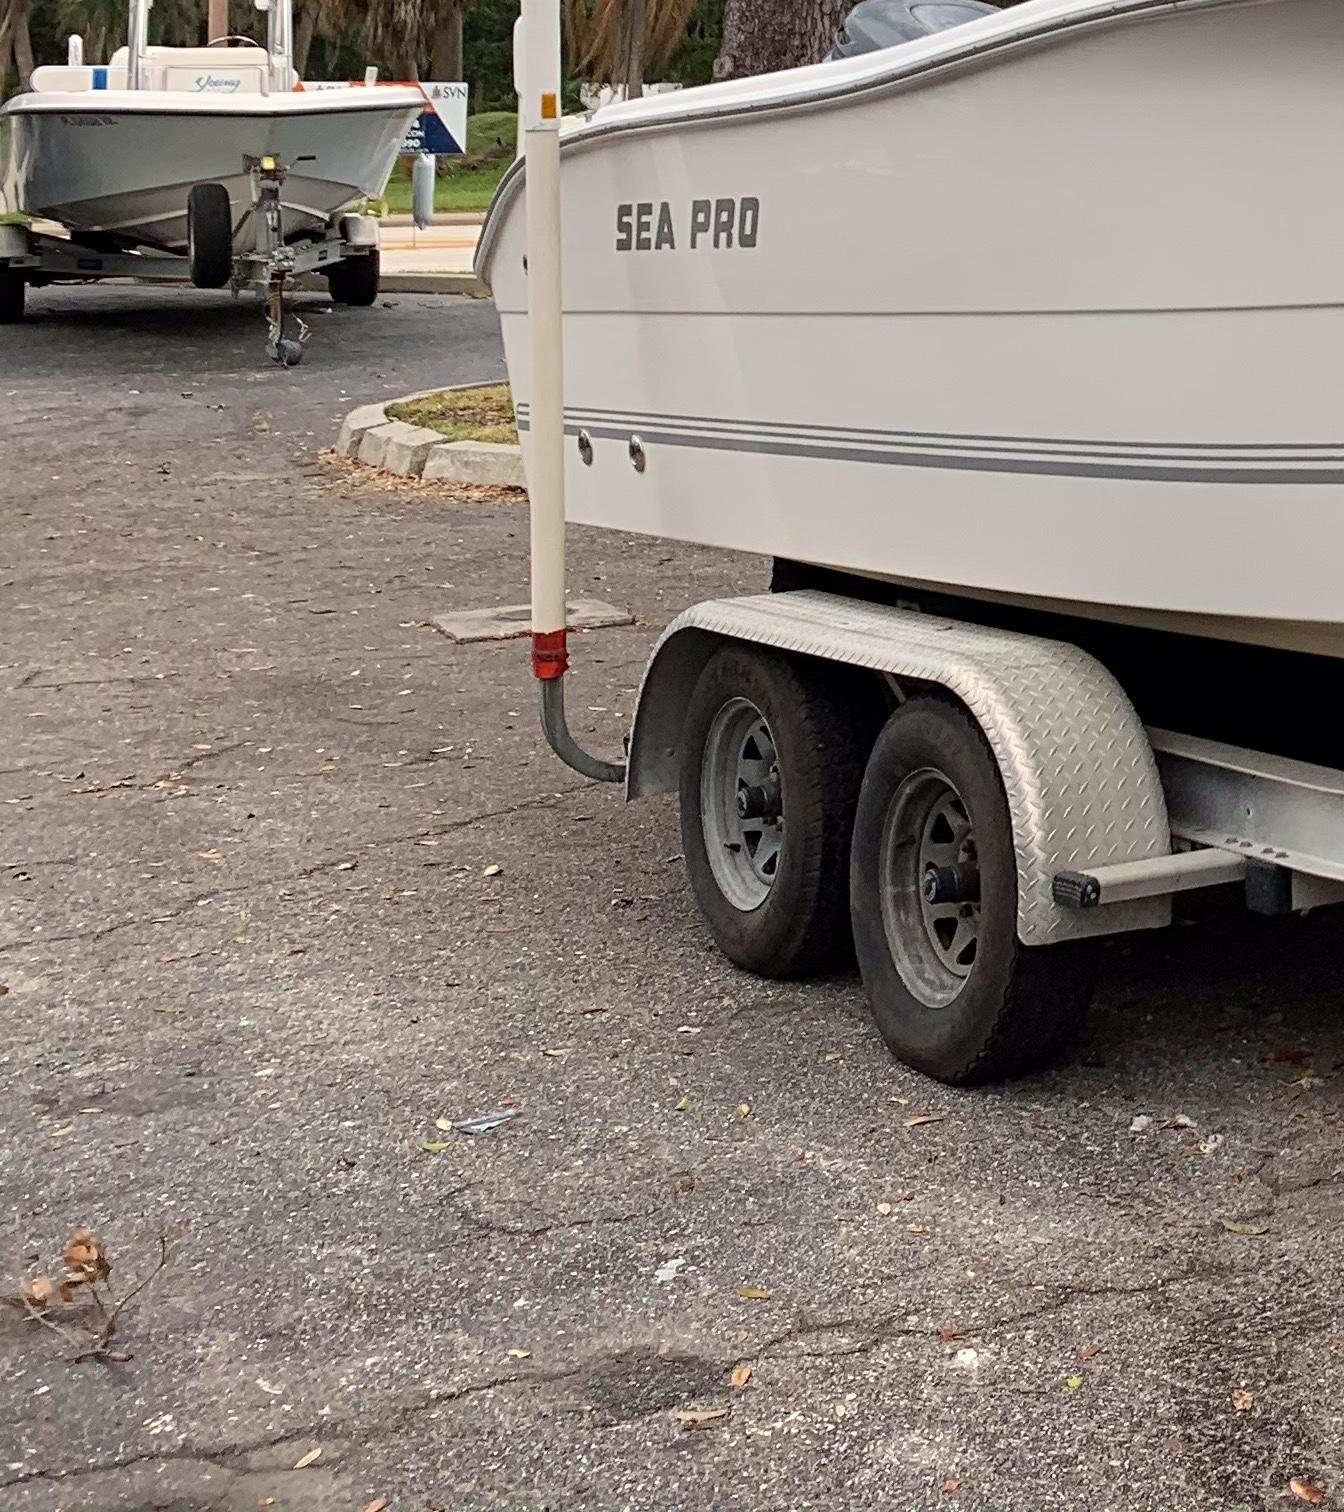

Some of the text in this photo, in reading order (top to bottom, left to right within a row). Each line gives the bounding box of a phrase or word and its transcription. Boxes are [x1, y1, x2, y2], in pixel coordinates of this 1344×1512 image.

[443, 86, 467, 99] SVN
[616, 196, 760, 252] SEA PRO
